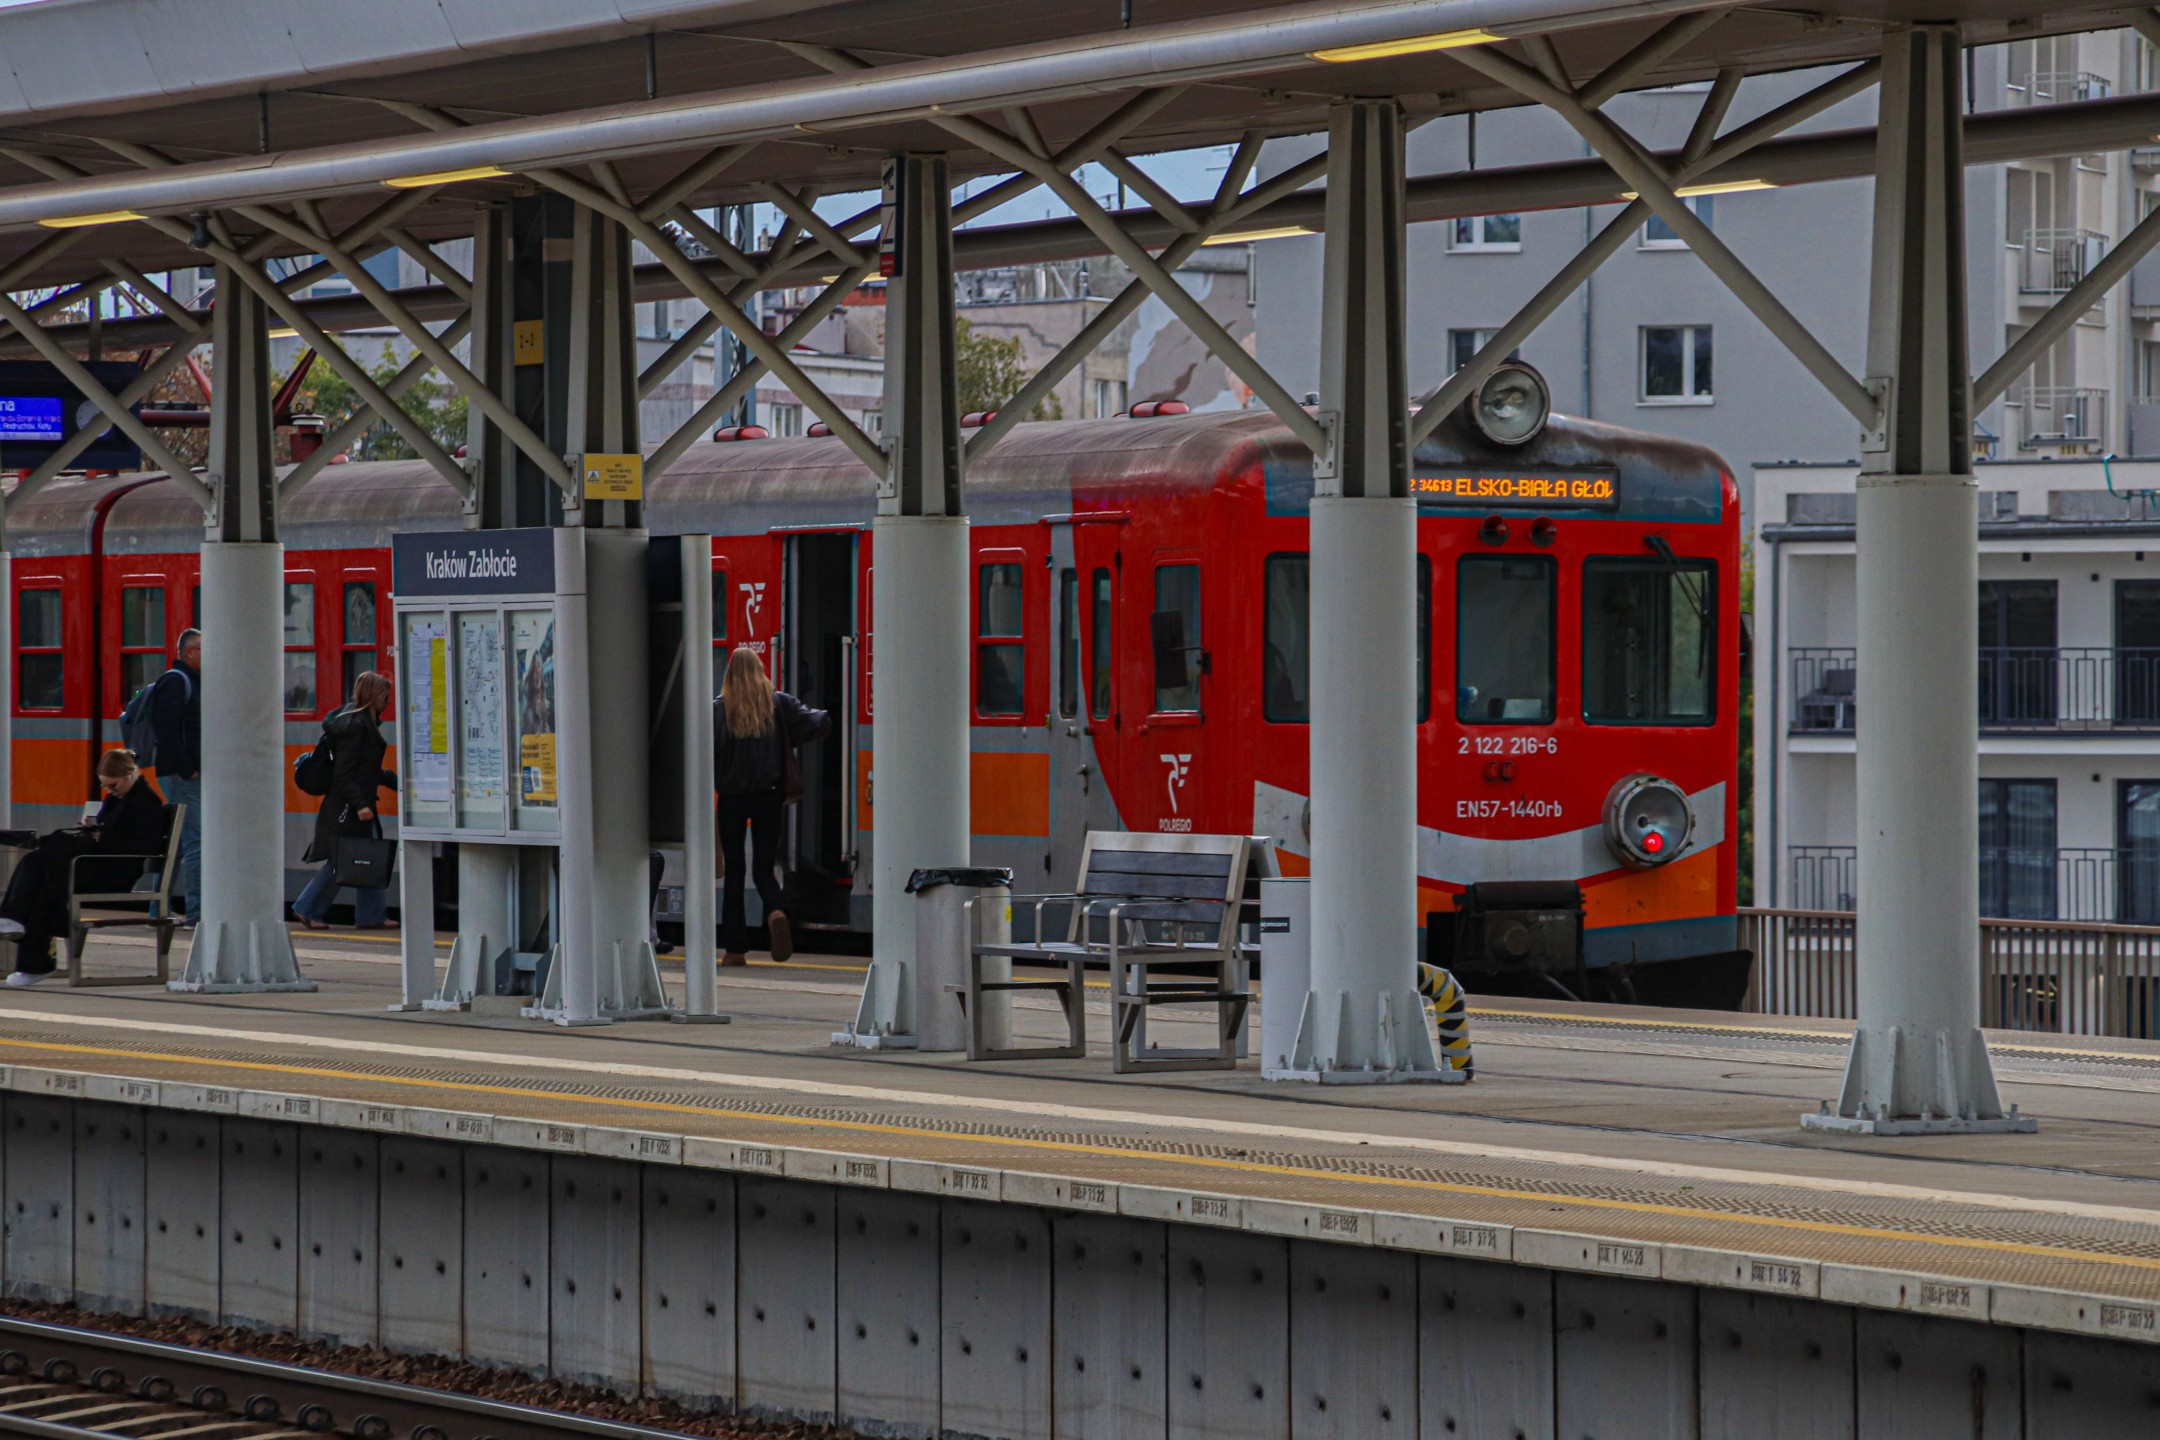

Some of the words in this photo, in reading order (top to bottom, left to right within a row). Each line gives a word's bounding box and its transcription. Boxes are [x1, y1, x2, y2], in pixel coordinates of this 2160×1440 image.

[1419, 478, 1453, 492] 34613
[426, 550, 467, 579] Kraków
[468, 548, 517, 578] Zabłocie
[1458, 737, 1470, 754] 2
[1475, 737, 1503, 754] 122
[1510, 737, 1558, 754] 216-6
[1456, 800, 1563, 818] EN57-1440rb
[1159, 818, 1192, 832] POLREGIO
